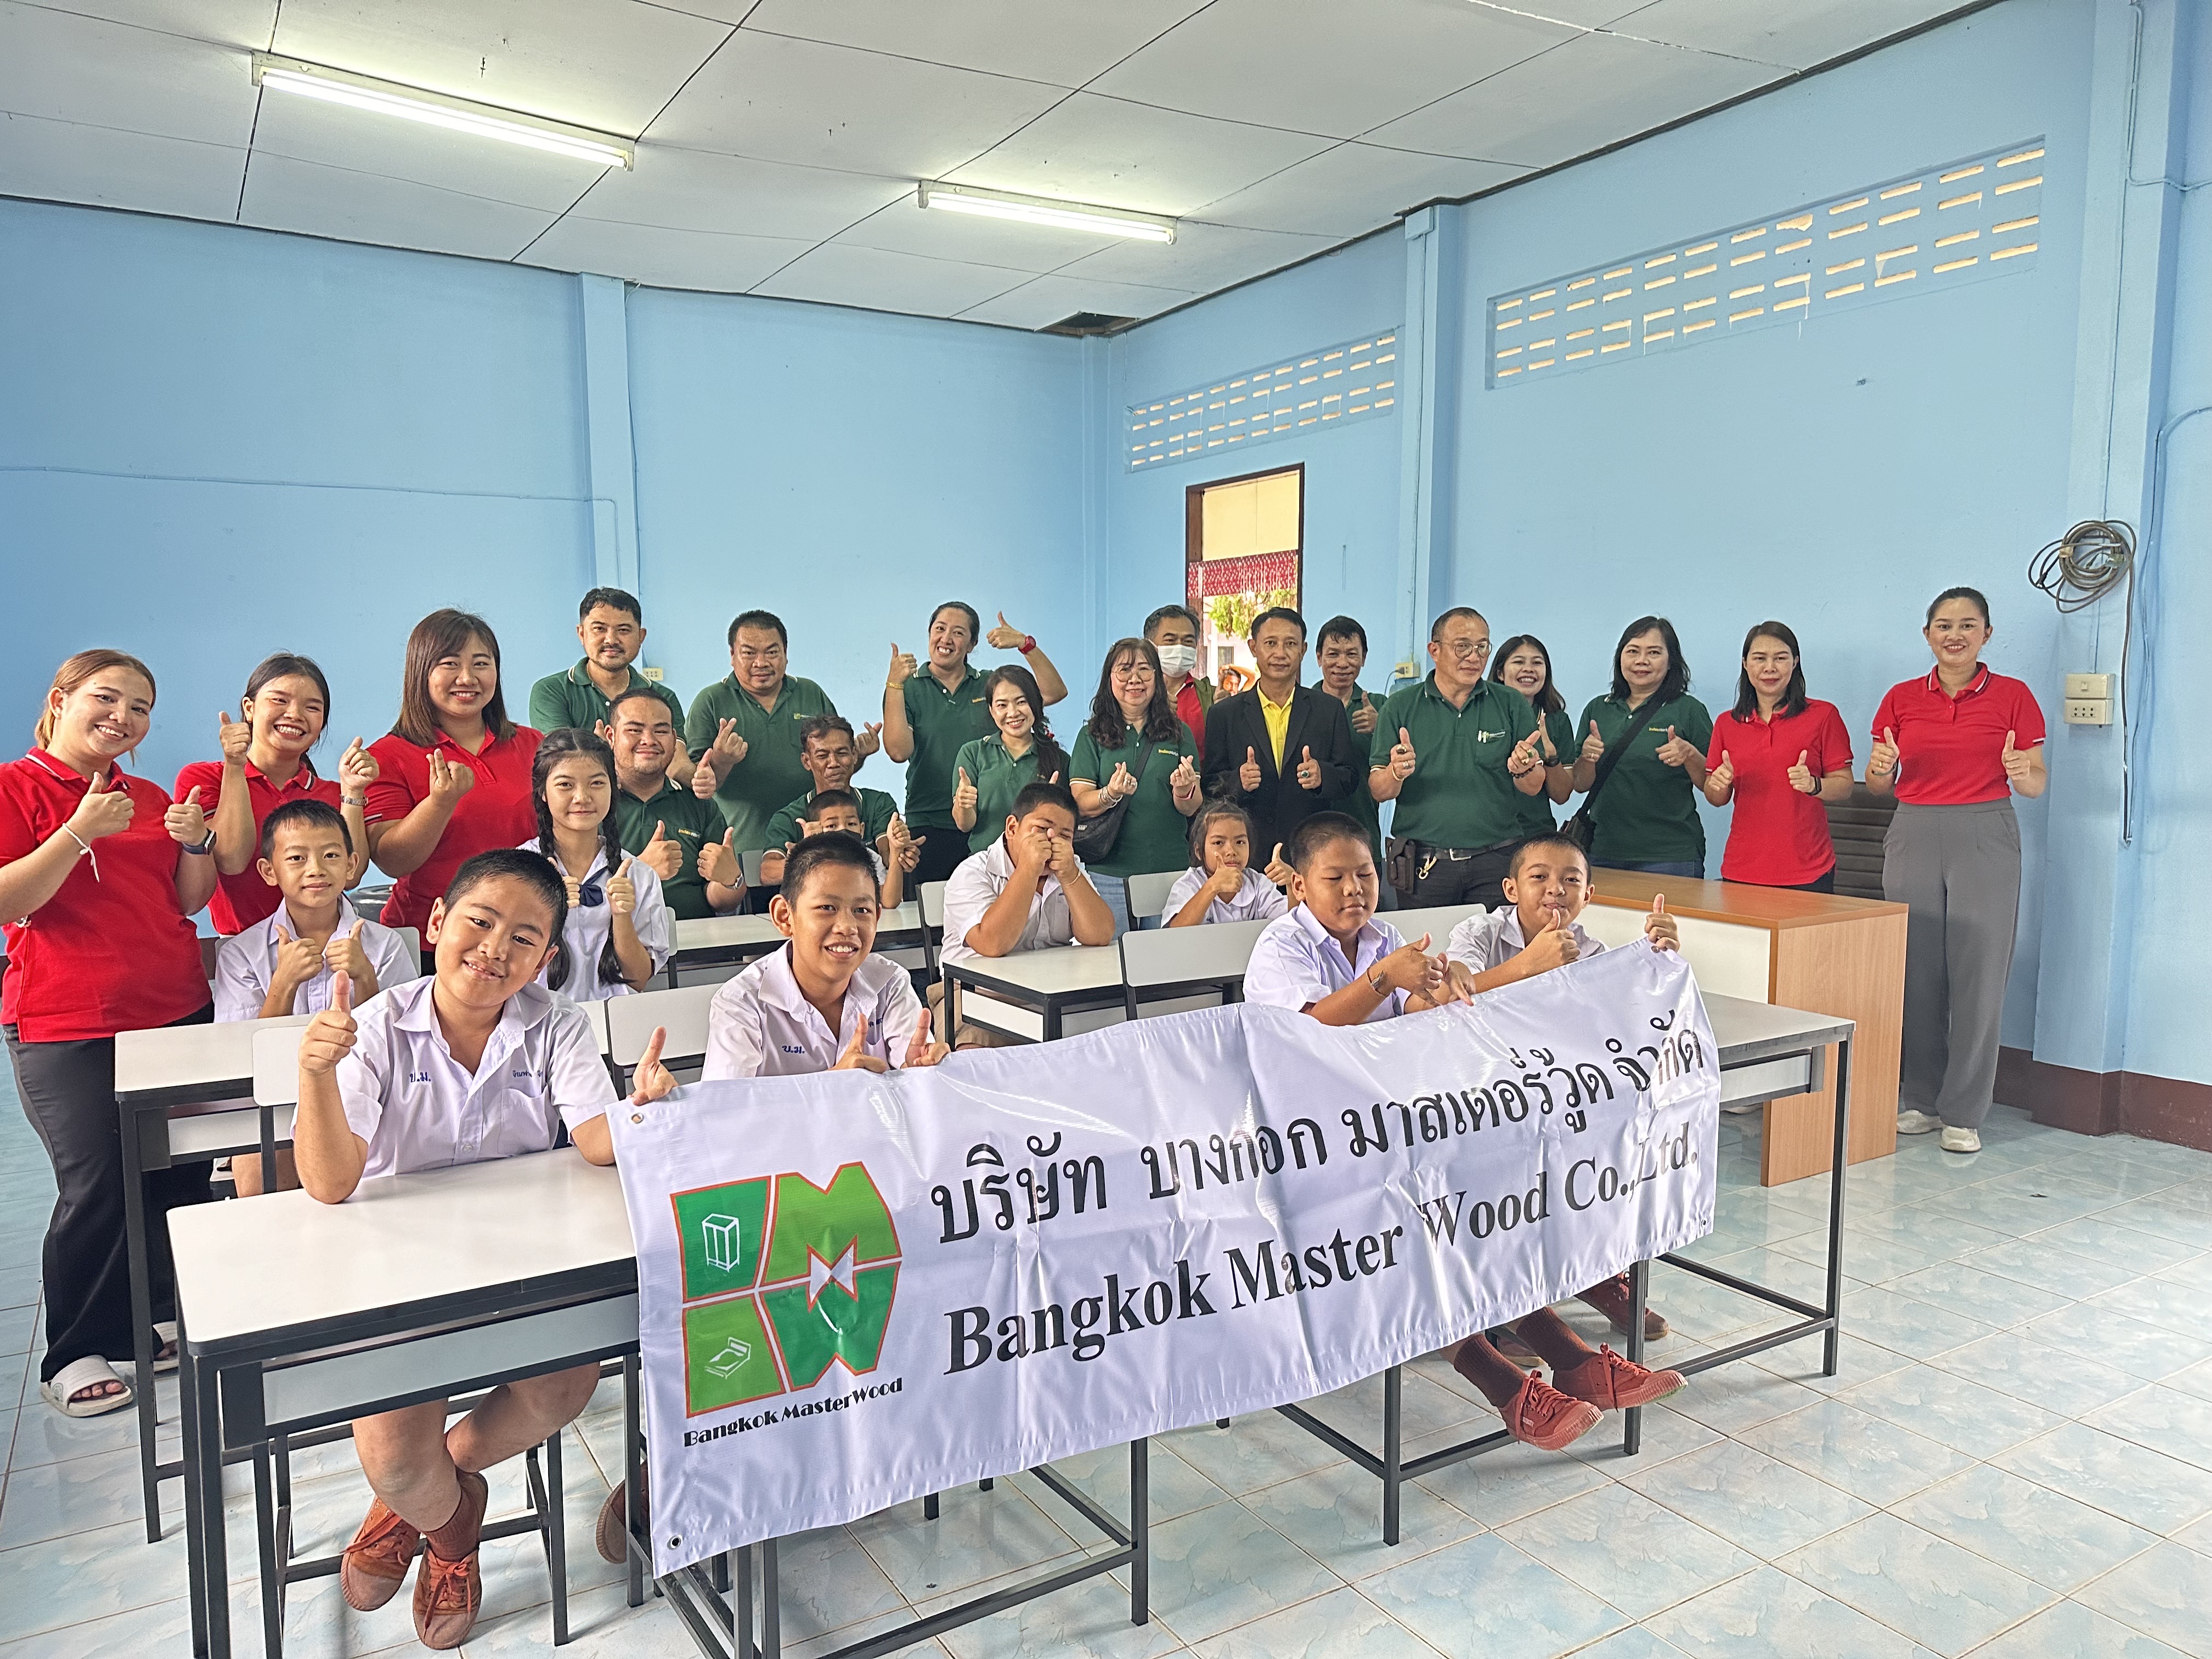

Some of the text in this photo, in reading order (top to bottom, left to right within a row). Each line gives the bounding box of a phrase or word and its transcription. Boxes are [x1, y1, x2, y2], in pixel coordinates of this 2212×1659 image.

[930, 1009, 1703, 1244] บริษัท บางกอก มาสเตอร์วู้ด จำกัด
[943, 1121, 1698, 1375] Bangkok Master Wood Co.,Ltd.
[684, 1410, 779, 1447] Bangkok
